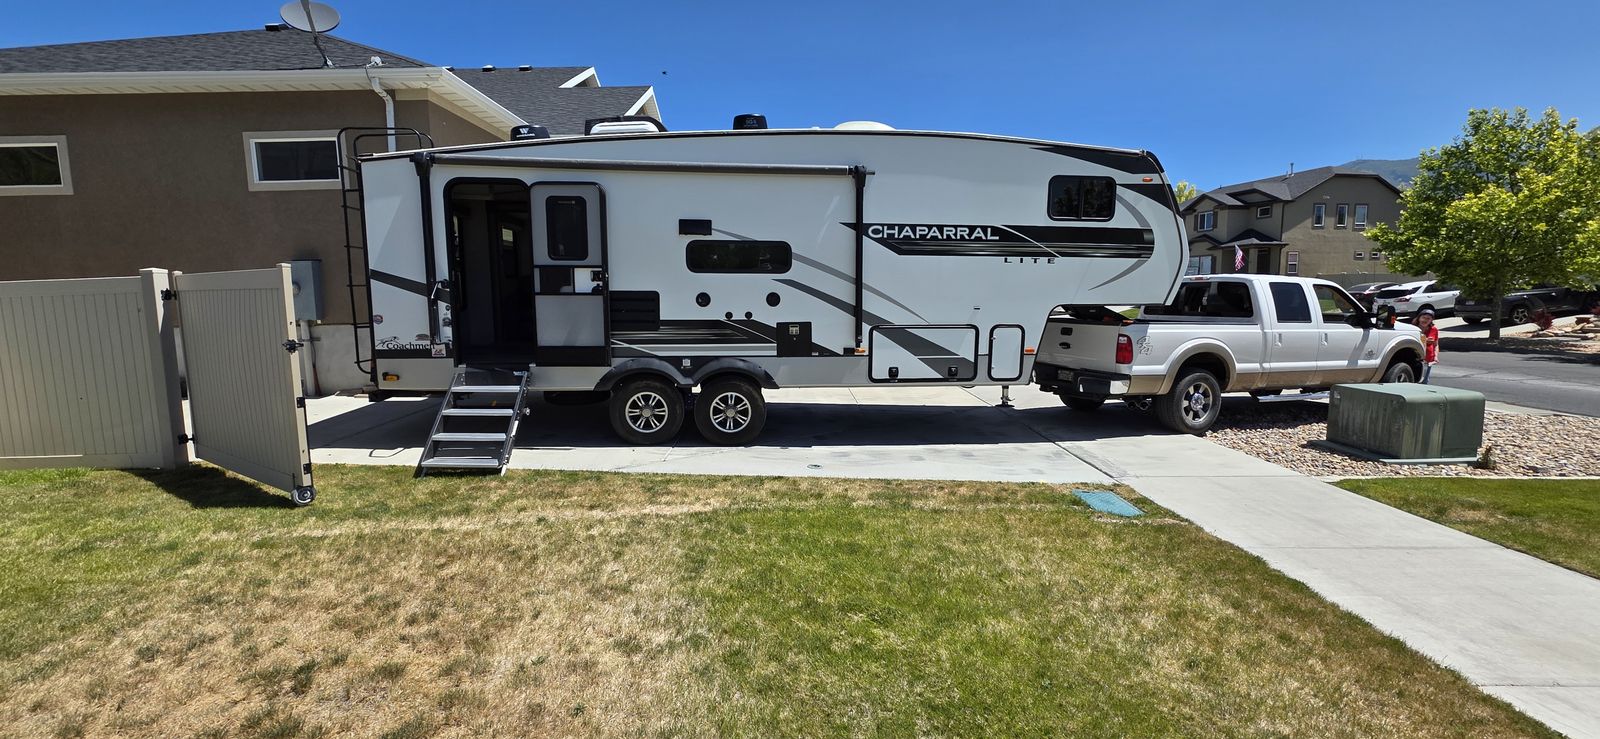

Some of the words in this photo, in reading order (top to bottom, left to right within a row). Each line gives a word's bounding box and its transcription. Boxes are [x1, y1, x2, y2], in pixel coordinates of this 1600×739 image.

[868, 225, 1000, 240] CHAPARRAL
[1004, 257, 1056, 265] LITE
[386, 342, 435, 350] Coachmen
